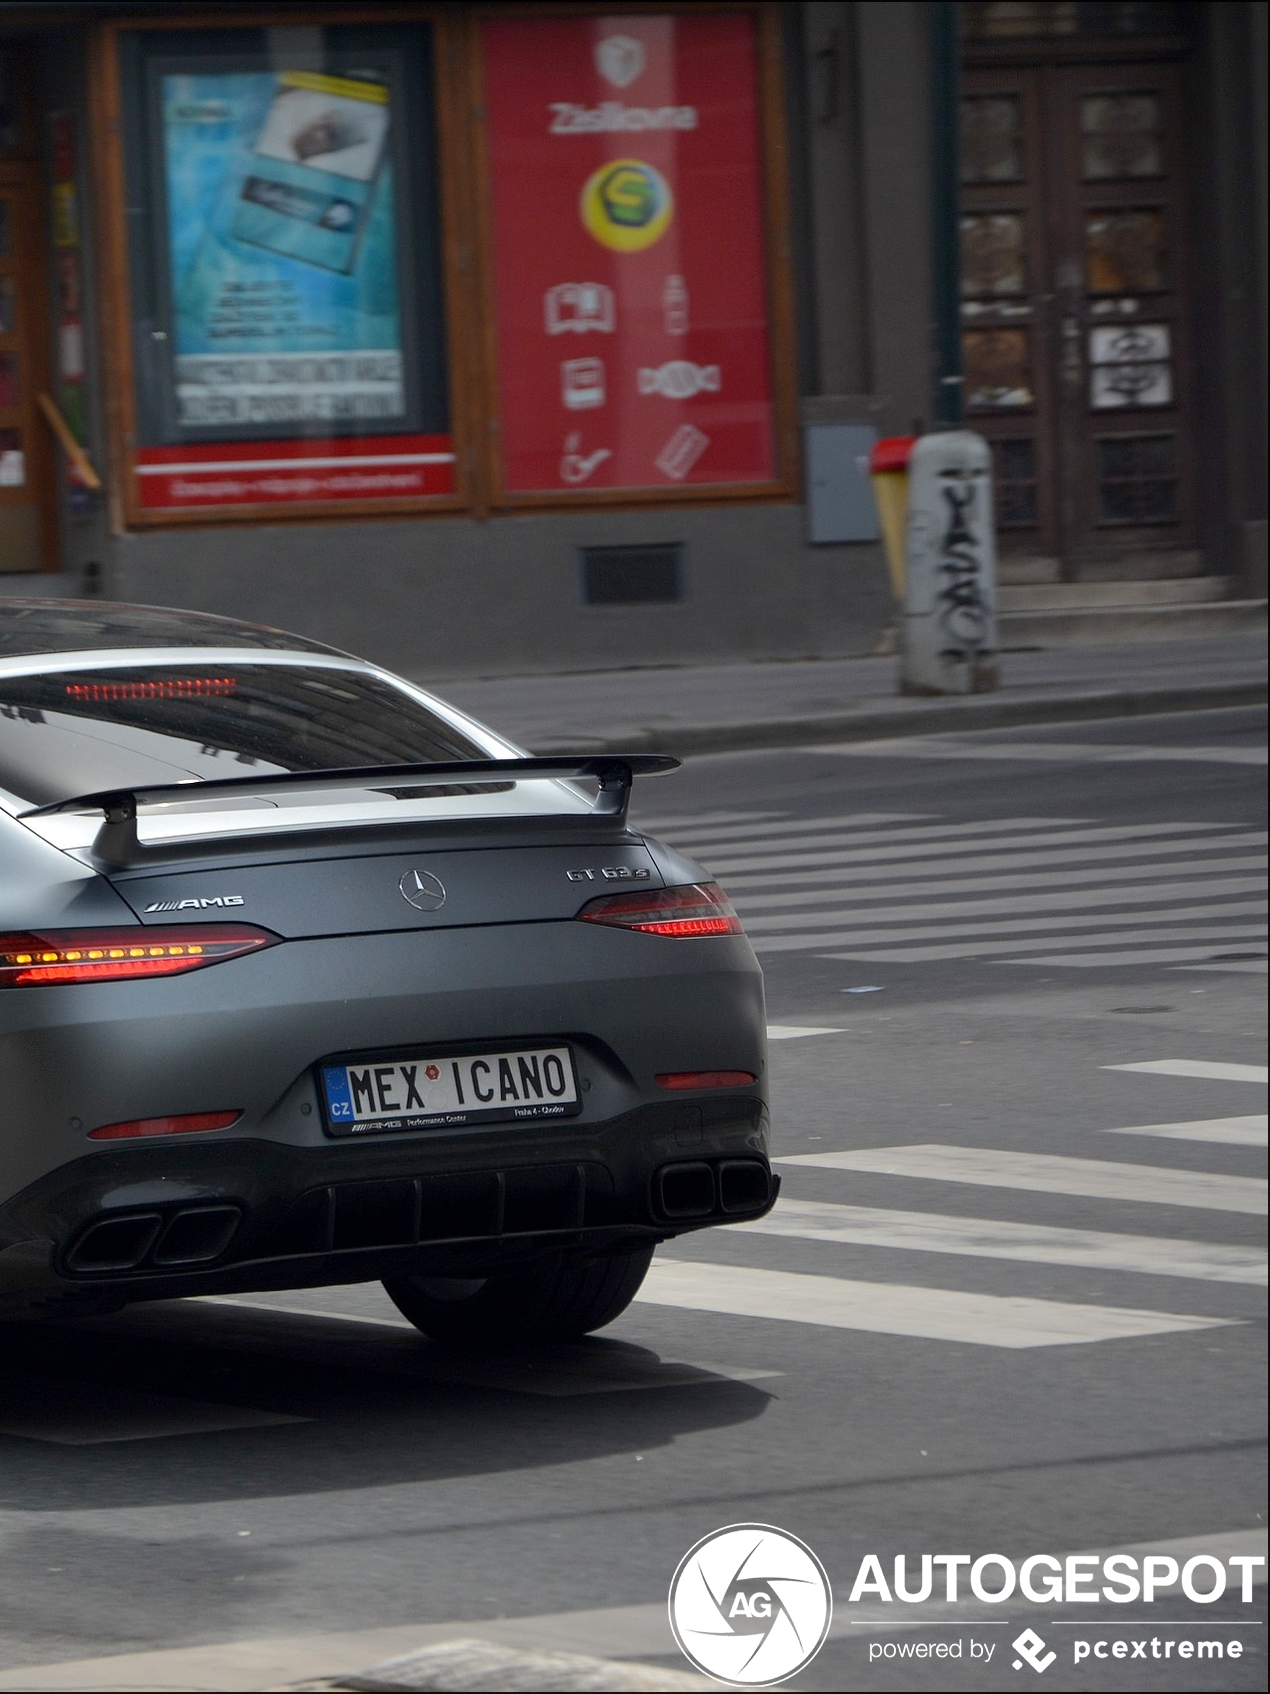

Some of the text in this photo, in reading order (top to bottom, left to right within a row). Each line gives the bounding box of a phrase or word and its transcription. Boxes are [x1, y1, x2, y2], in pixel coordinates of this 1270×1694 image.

[566, 868, 595, 881] GT
[601, 866, 632, 879] 63
[175, 896, 245, 910] AMG
[350, 1054, 566, 1114] MEX ICANO
[332, 1102, 350, 1116] CZ
